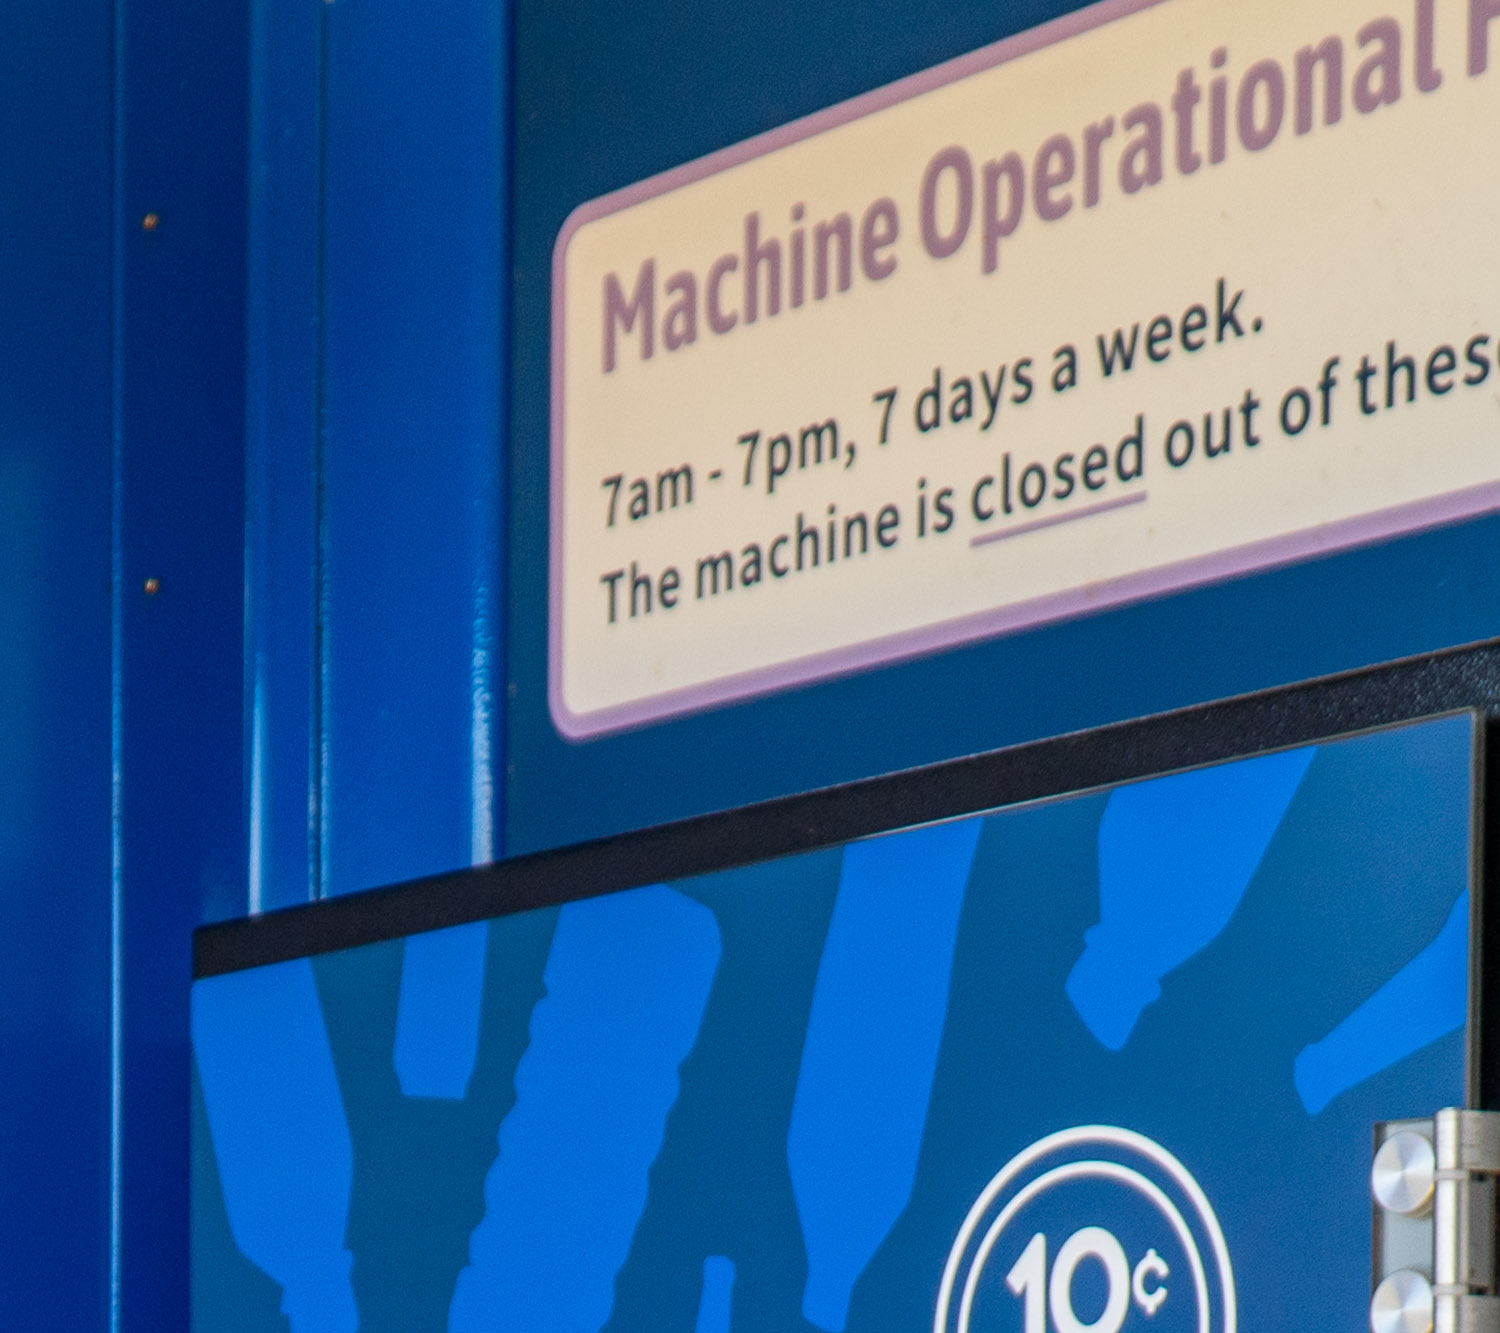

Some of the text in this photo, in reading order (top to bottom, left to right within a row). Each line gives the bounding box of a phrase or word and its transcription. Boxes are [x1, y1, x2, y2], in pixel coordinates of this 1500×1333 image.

[601, 0, 1441, 375] Machine Operational
[600, 561, 681, 624] The
[695, 503, 901, 600] machine
[917, 477, 955, 539] is
[971, 413, 1146, 538] closed
[1164, 389, 1260, 469] out
[1279, 356, 1340, 437] of
[601, 277, 1263, 528] 7am 7pm, 7 days a week.
